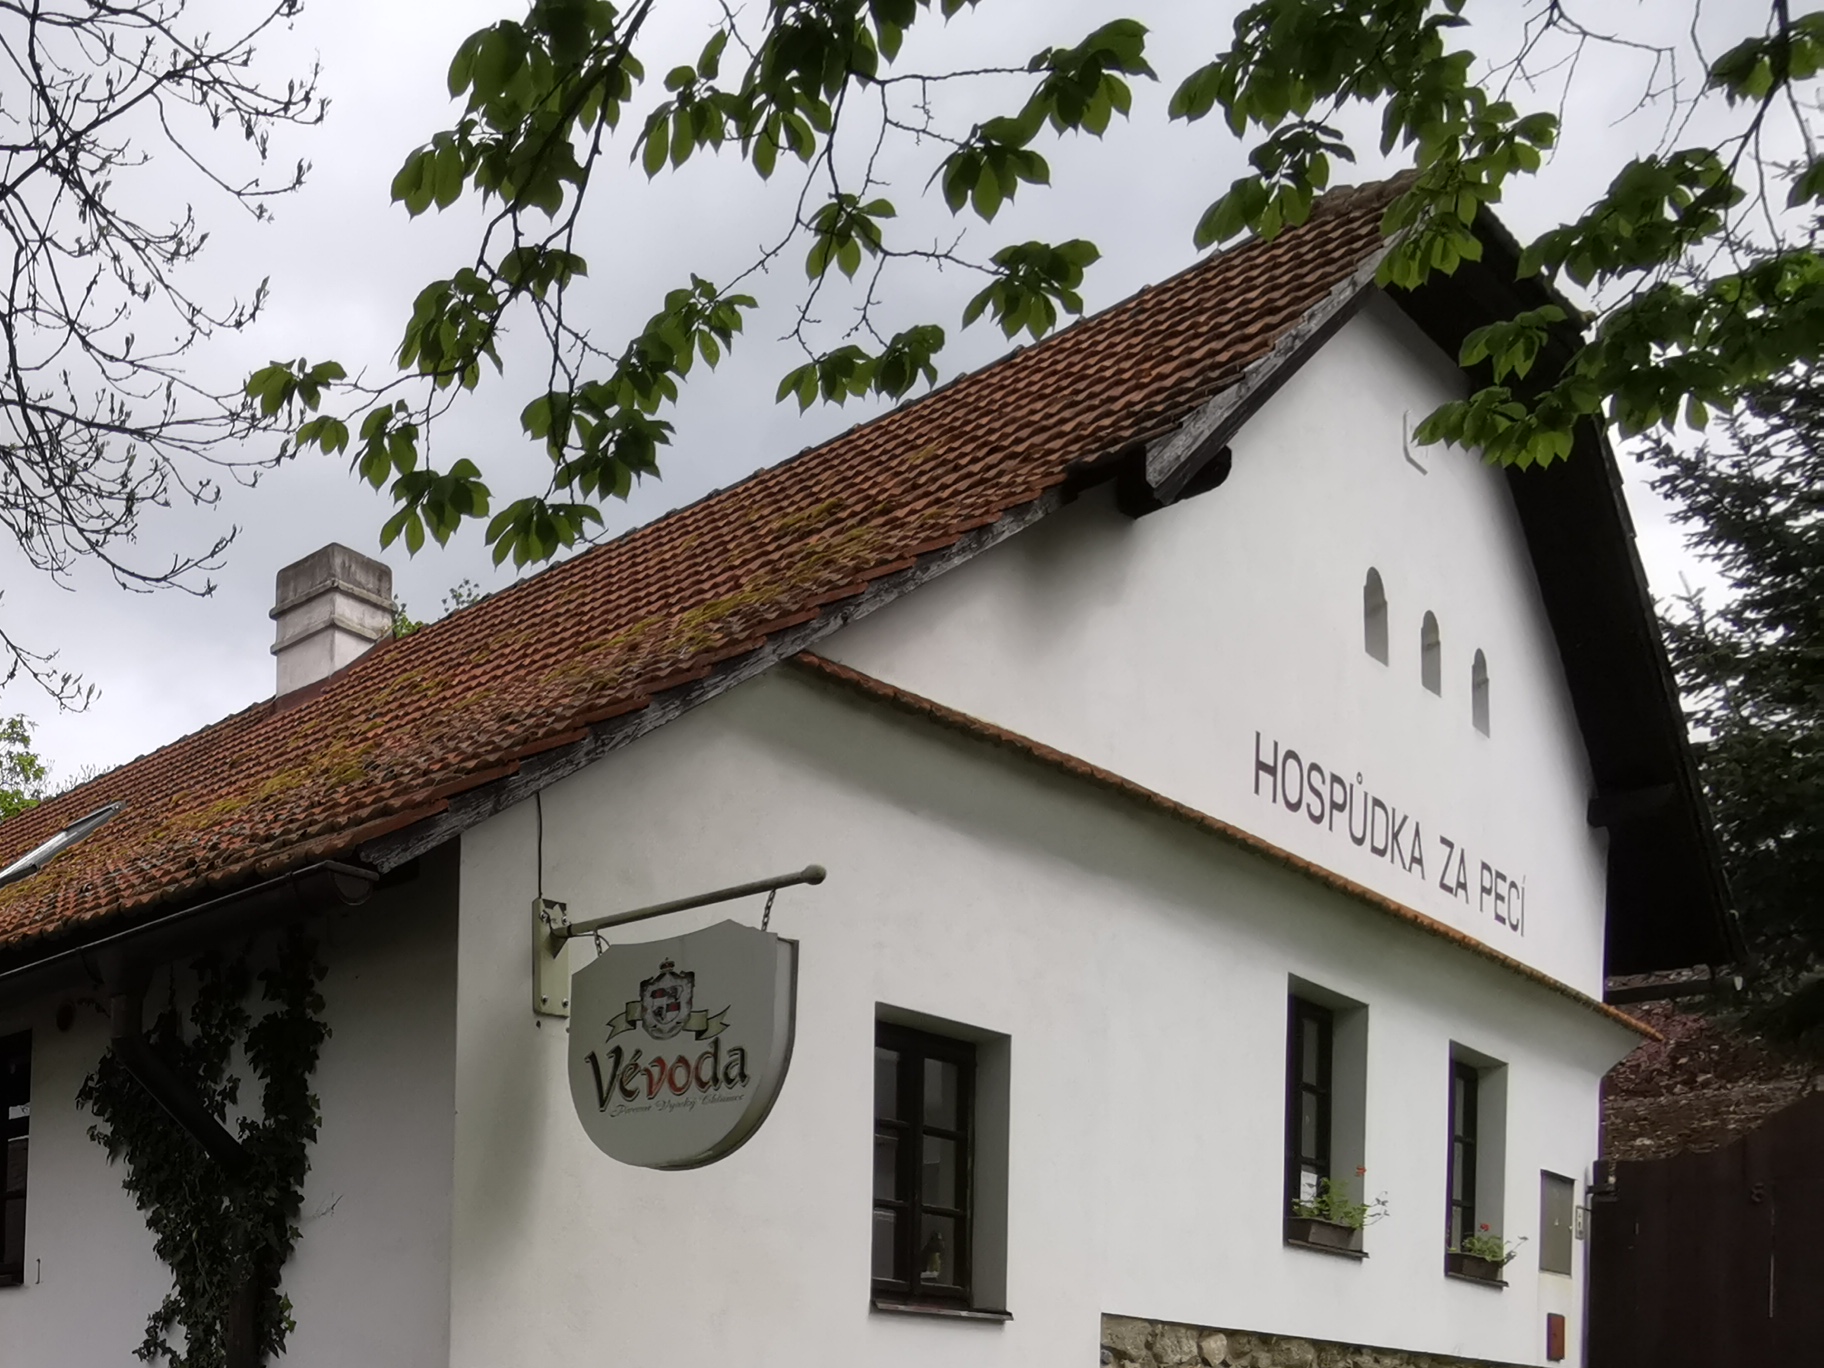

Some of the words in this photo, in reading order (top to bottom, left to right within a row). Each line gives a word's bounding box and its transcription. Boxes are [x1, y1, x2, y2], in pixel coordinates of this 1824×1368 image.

[1253, 730, 1426, 881] HOSPŮDKA
[1438, 834, 1470, 905] ZA
[1479, 858, 1526, 938] PECÍ
[584, 1036, 751, 1113] Vévoda
